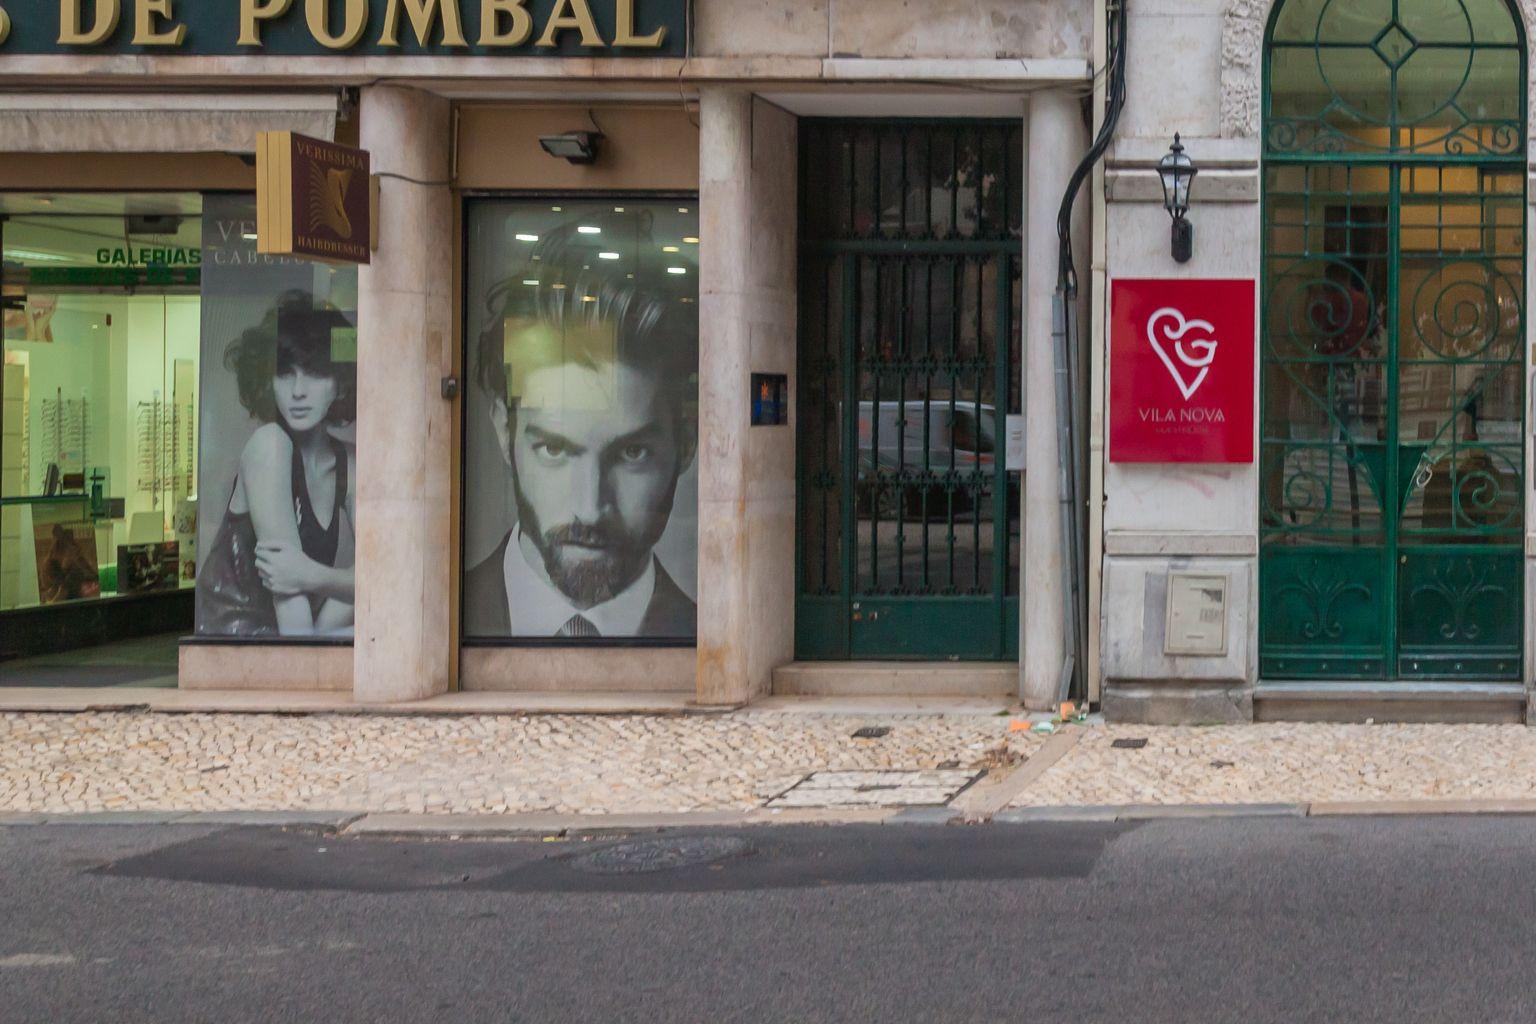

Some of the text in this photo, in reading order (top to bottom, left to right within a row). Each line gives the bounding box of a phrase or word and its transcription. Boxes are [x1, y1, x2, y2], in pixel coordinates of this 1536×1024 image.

[296, 141, 364, 170] VERISSIMA
[297, 236, 366, 257] HAIRDRESSER
[96, 248, 201, 264] GALERIAS
[1139, 408, 1225, 422] VILA NOVA
